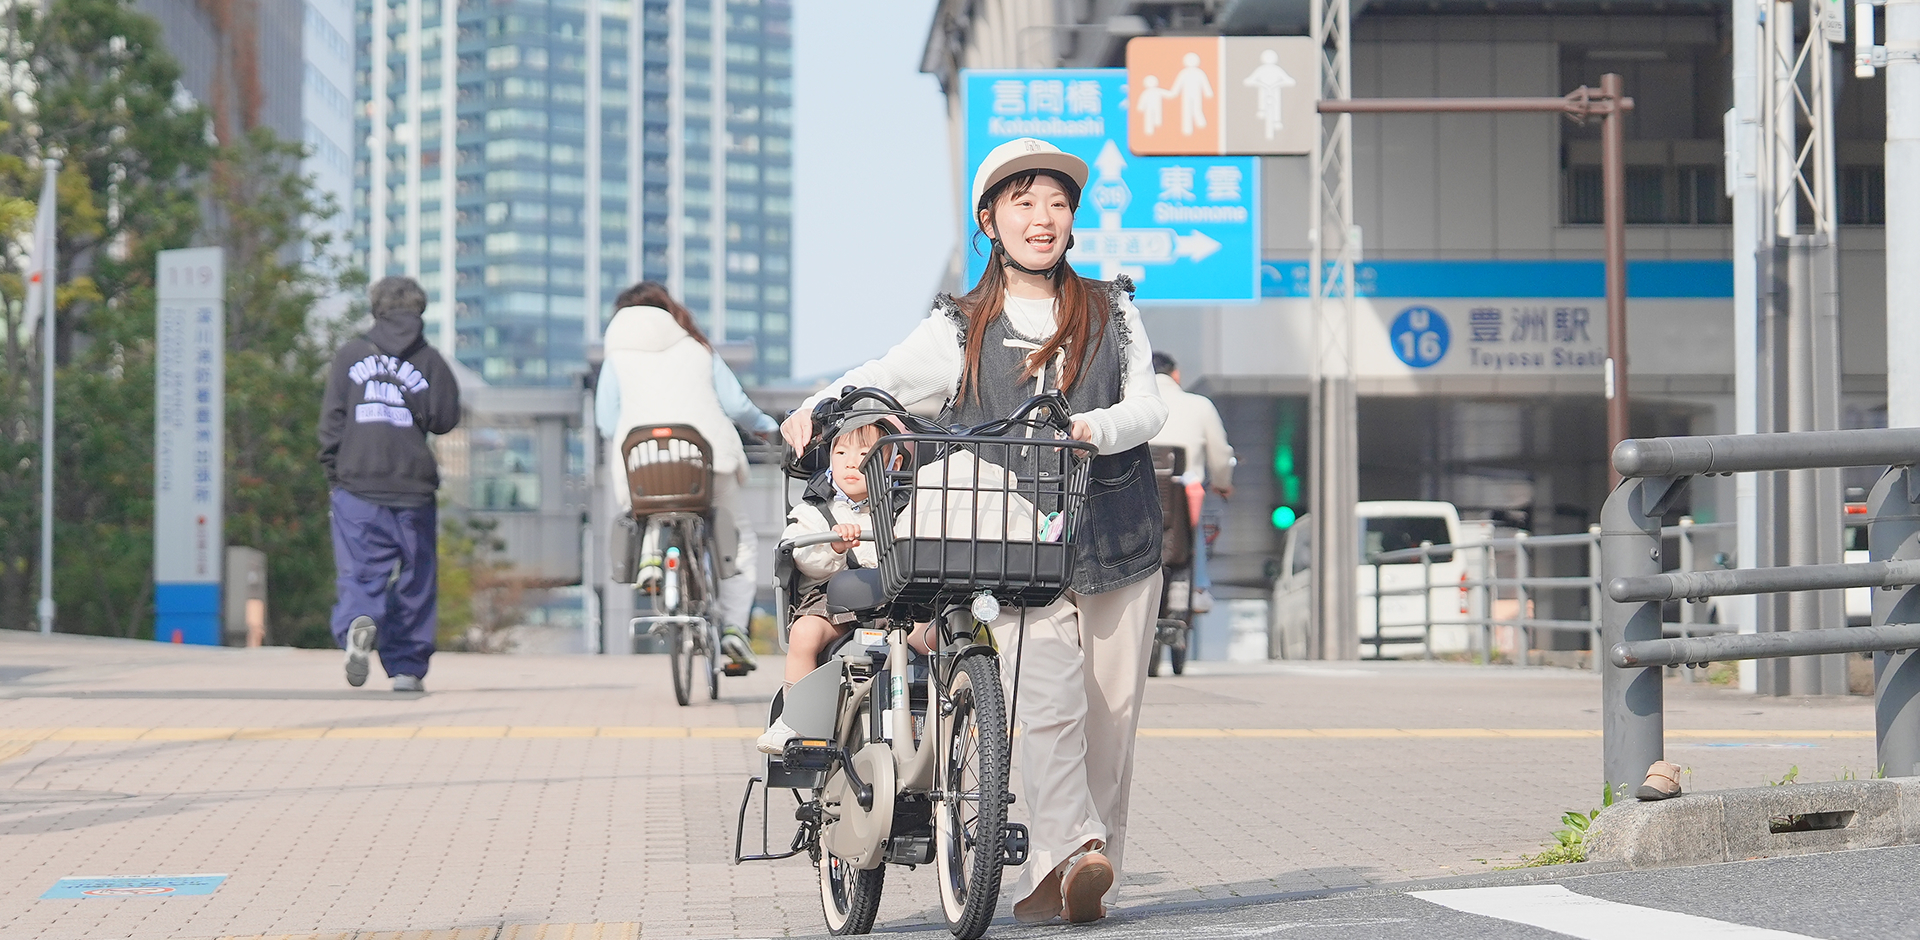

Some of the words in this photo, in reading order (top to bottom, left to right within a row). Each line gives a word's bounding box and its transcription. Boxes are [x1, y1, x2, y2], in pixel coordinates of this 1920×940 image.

[991, 80, 1103, 115] 言問橋
[988, 116, 1105, 136] Kototobashi
[1158, 165, 1243, 202] 東雲
[1154, 202, 1247, 224] Shinonome
[168, 265, 214, 286] 119
[1409, 308, 1430, 331] U
[1469, 306, 1591, 343] 豊洲駅
[1398, 332, 1441, 361] 16
[1468, 347, 1545, 370] Toyosu
[1553, 347, 1606, 367] Stati
